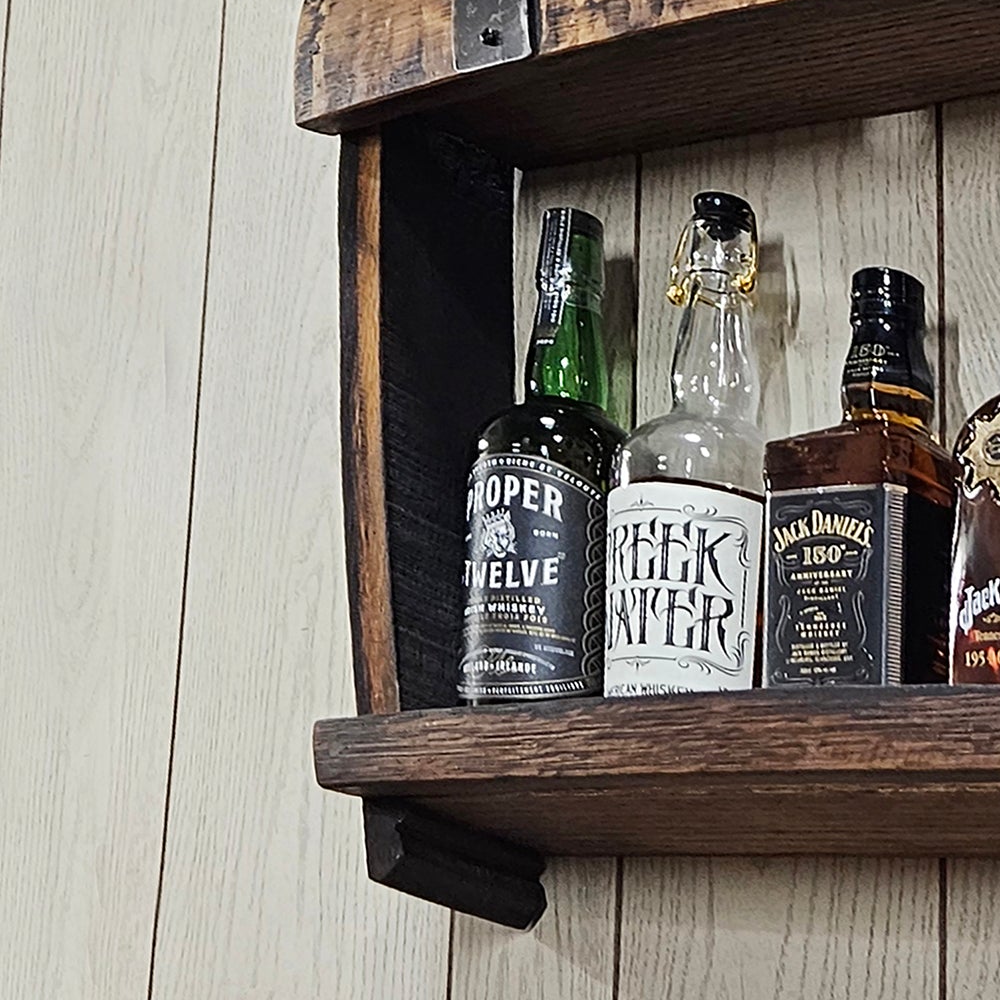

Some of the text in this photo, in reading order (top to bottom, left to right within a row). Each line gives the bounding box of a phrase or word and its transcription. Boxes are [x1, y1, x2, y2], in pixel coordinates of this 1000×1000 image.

[772, 508, 875, 553] JACK DANIEL'S
[463, 556, 561, 590] TWELVE
[789, 568, 854, 581] ANNIVERSARY
[486, 602, 546, 617] WHISKEY
